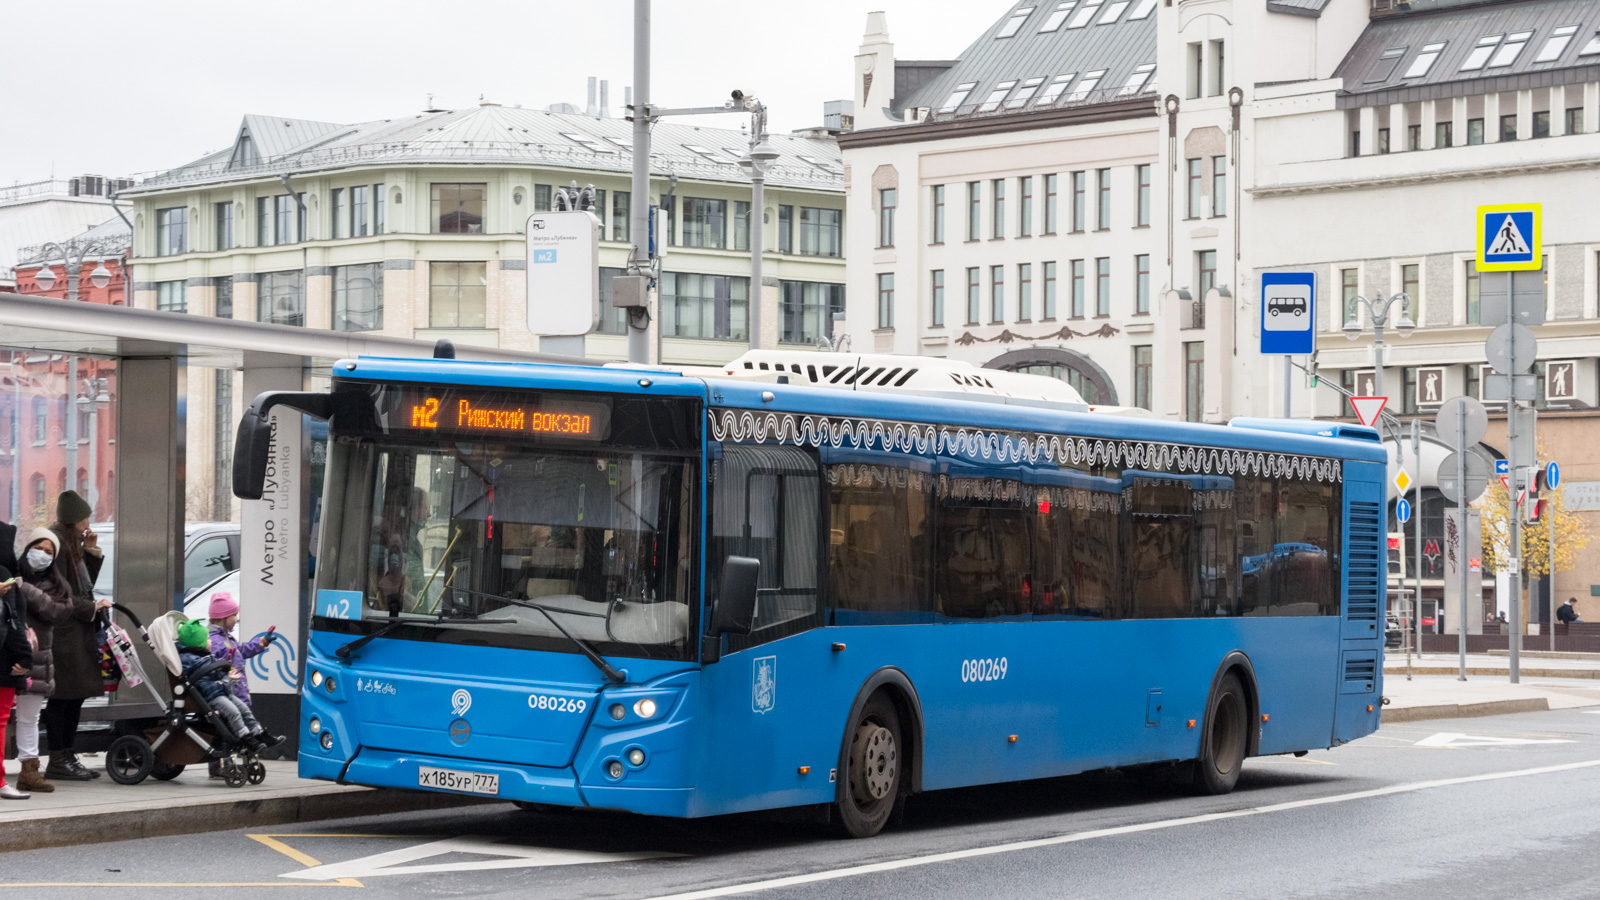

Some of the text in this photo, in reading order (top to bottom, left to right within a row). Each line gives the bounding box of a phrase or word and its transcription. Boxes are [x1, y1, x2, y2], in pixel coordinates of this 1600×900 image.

[458, 399, 525, 430] Рижский
[532, 412, 591, 434] вокзал
[278, 445, 291, 560] Metro Lubyanka
[260, 519, 277, 586] Метро
[961, 656, 1008, 683] 080269
[527, 694, 587, 714] 080269
[474, 774, 495, 788] 777
